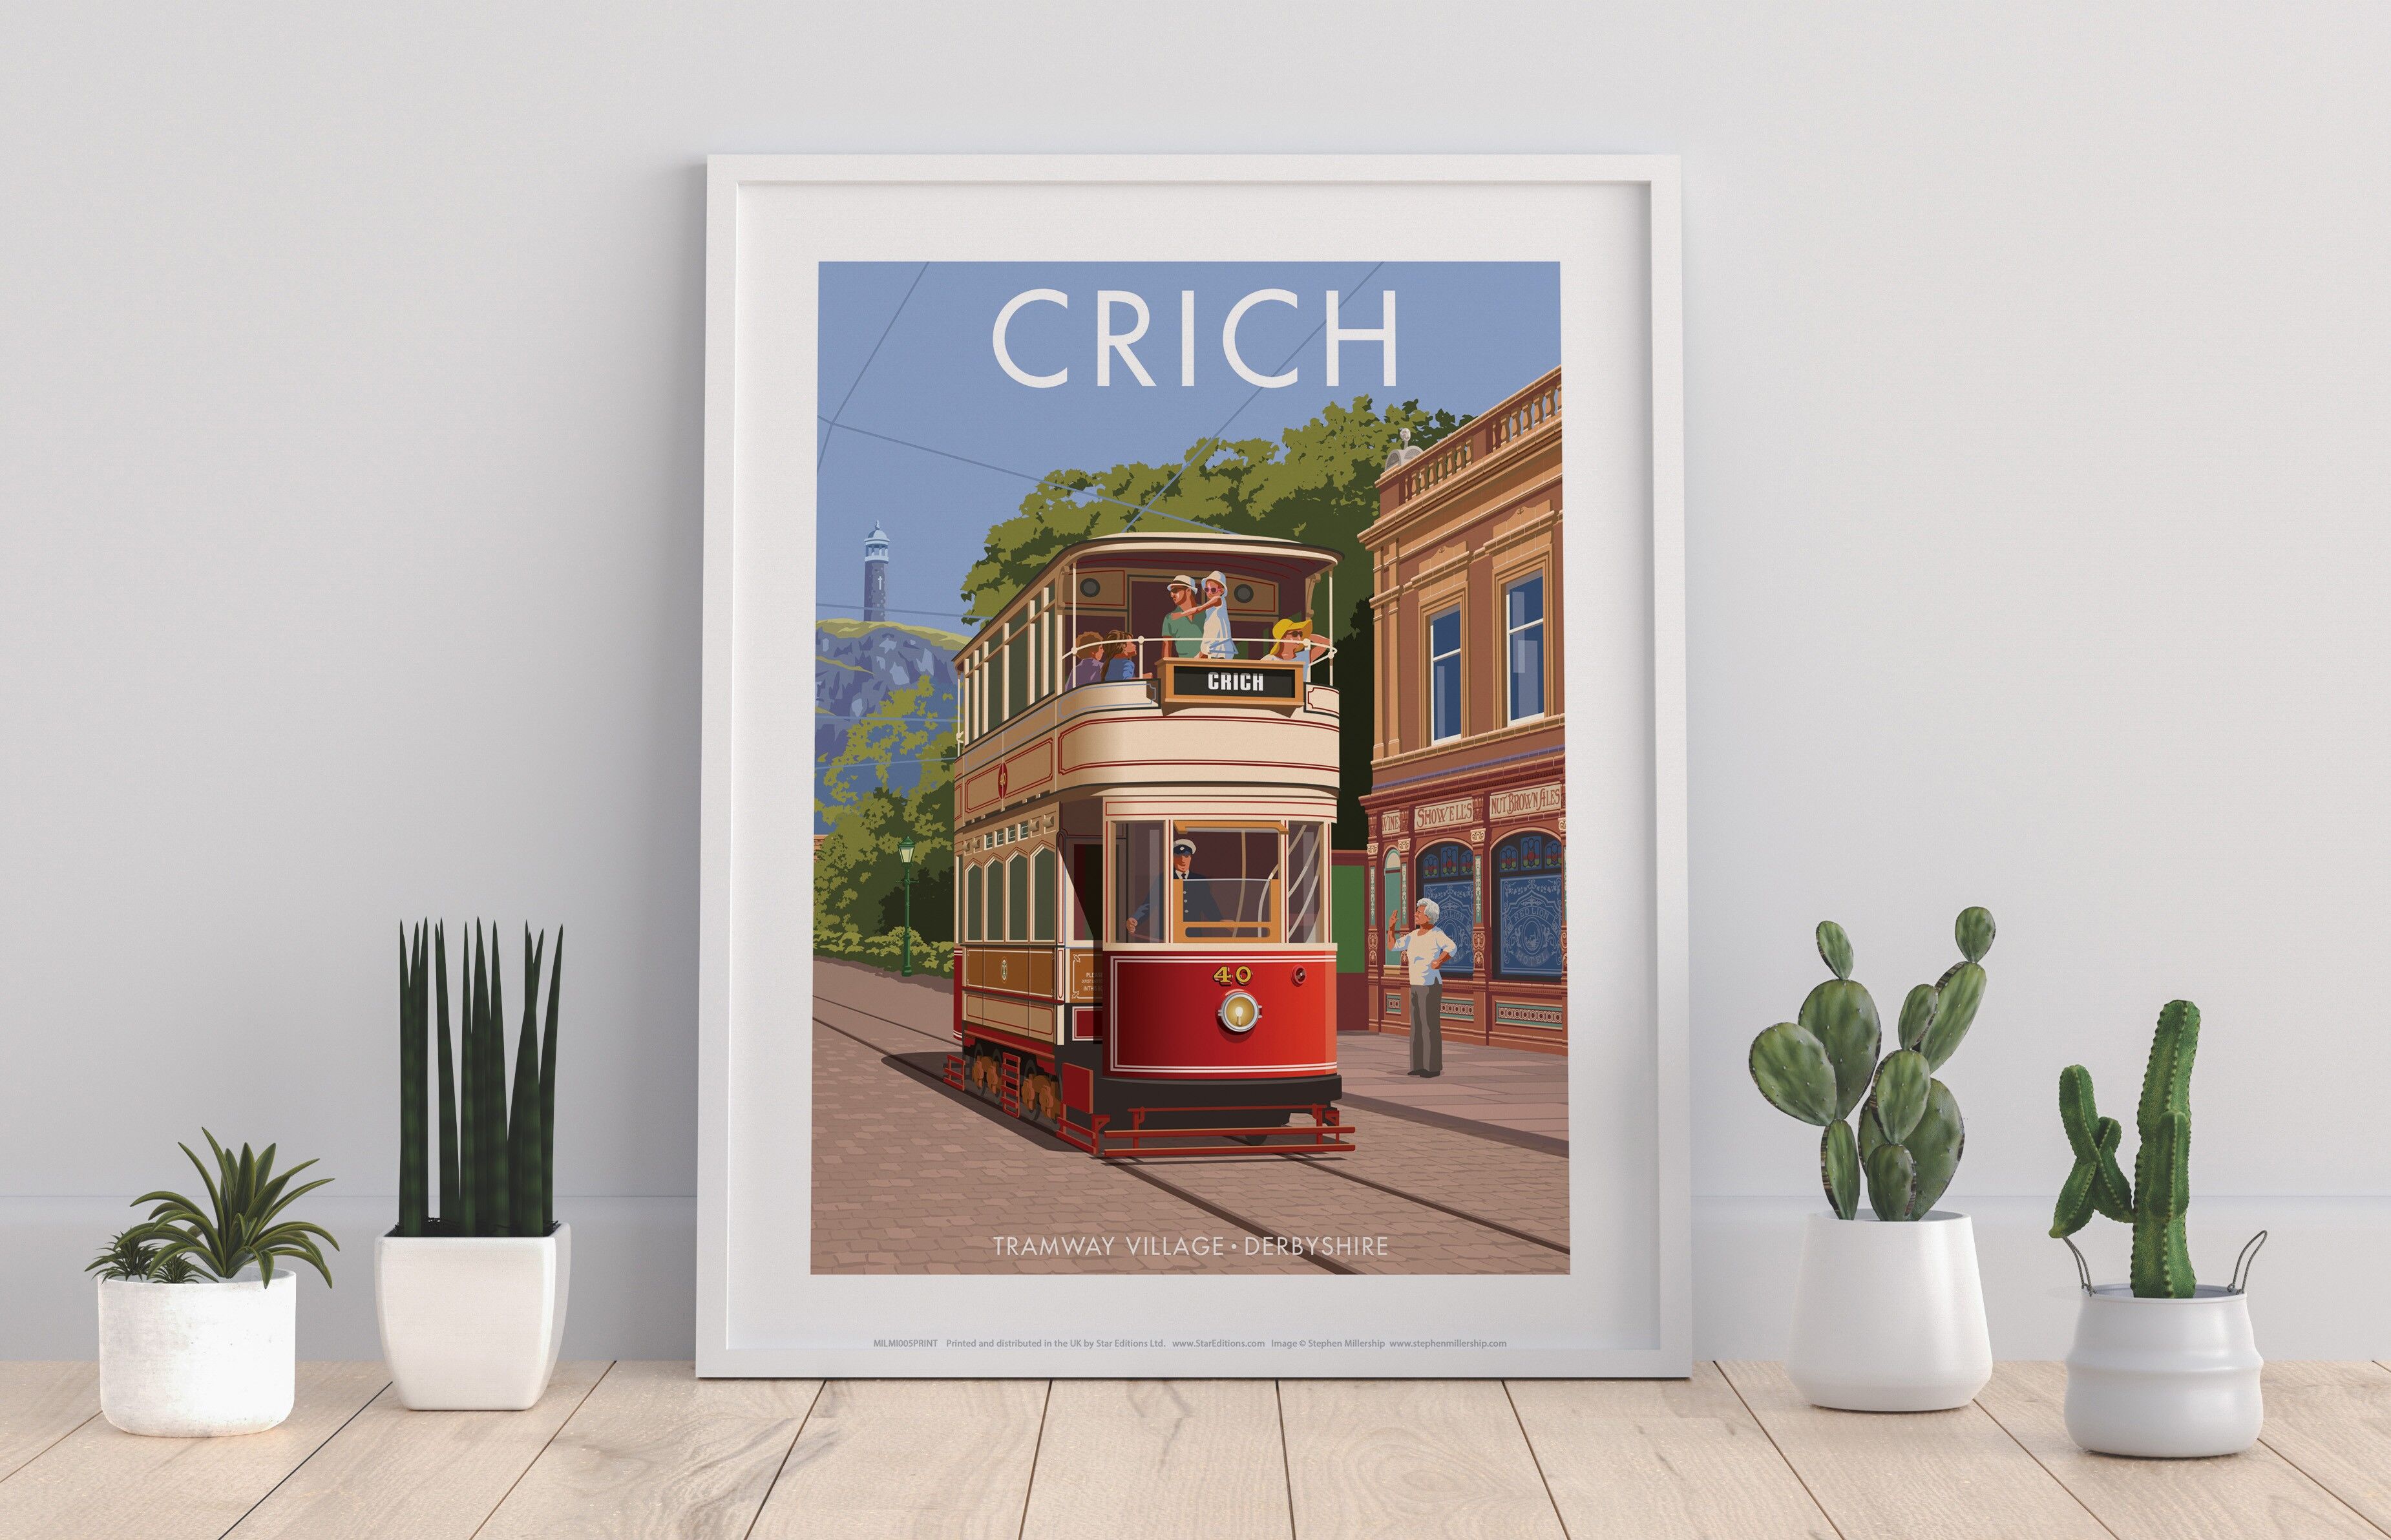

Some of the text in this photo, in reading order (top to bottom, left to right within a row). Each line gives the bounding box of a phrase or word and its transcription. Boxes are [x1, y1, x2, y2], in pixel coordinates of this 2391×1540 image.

[993, 288, 1396, 389] CRICH
[1208, 672, 1263, 691] CRICH
[1491, 788, 1561, 815] NUT BROWN ALES
[1417, 803, 1473, 828] SHOWELL'S
[1514, 907, 1550, 922] RED LION
[1517, 950, 1549, 966] HOTEL
[1213, 965, 1254, 987] 40
[993, 1236, 1388, 1256] TRAMWAY VILLAGE DERBYSHIRE
[873, 1339, 938, 1347] MILMI005PRINT
[946, 1339, 976, 1347] Printed
[978, 1339, 995, 1347] and
[996, 1339, 1042, 1347] distributed
[1044, 1339, 1052, 1347] in
[1054, 1339, 1068, 1347] the
[1070, 1339, 1082, 1347] UK
[1084, 1339, 1095, 1349] by
[1096, 1339, 1113, 1347] Star
[1114, 1339, 1148, 1347] Editions
[1150, 1339, 1166, 1347] Ltd.
[1172, 1339, 1265, 1347] www.StarEditions.com
[1271, 1339, 1298, 1349] Image
[1308, 1339, 1342, 1349] Stephen
[1344, 1339, 1385, 1349] Millership
[1389, 1339, 1508, 1349] www.stephenmillership.com
